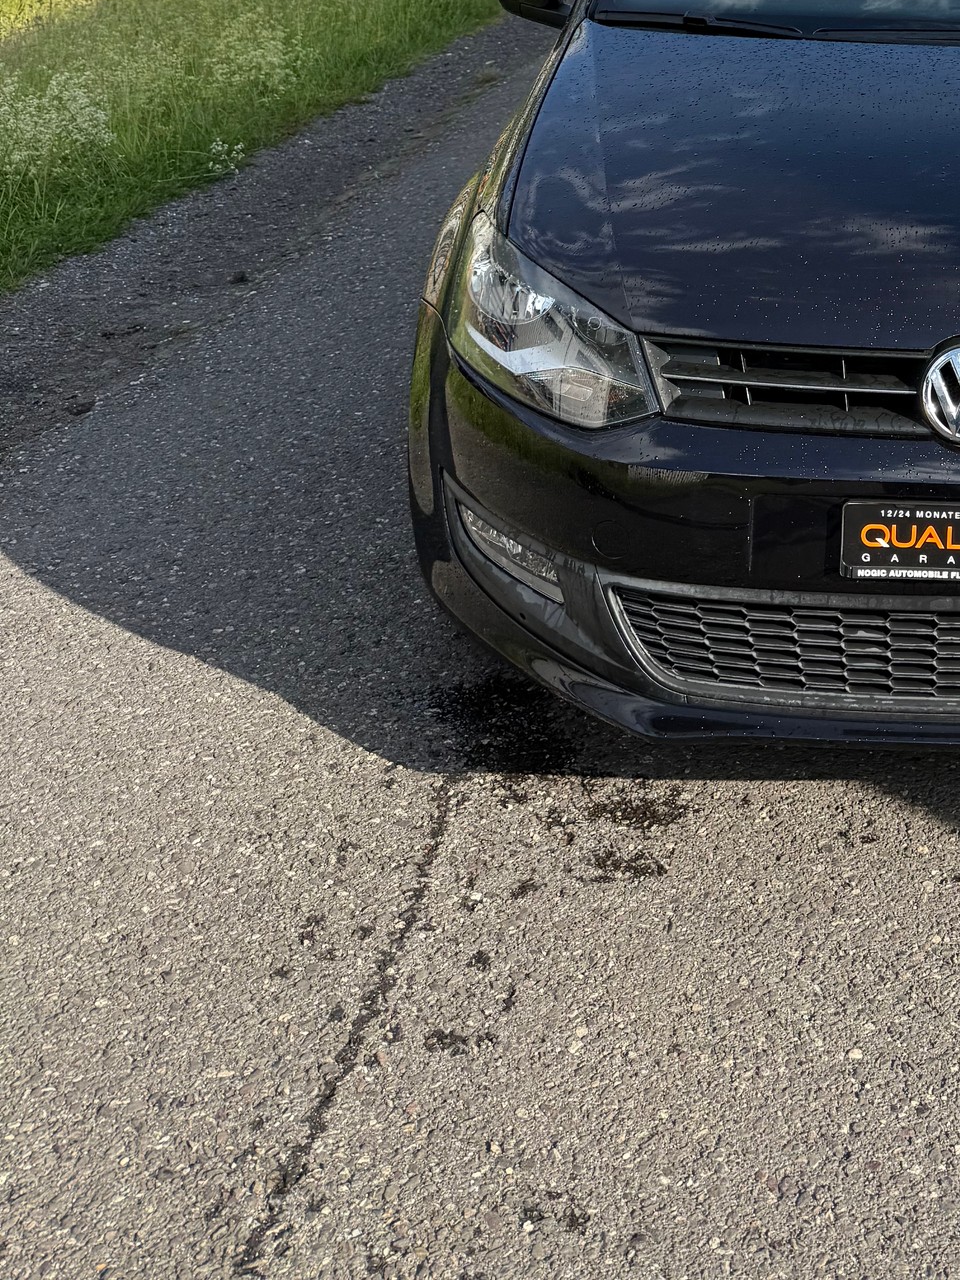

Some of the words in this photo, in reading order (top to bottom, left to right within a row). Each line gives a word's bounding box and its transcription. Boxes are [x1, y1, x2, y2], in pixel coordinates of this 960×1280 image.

[880, 510, 911, 518] 12/24
[916, 511, 960, 520] MONATE
[889, 569, 949, 579] AUTOMOBILE
